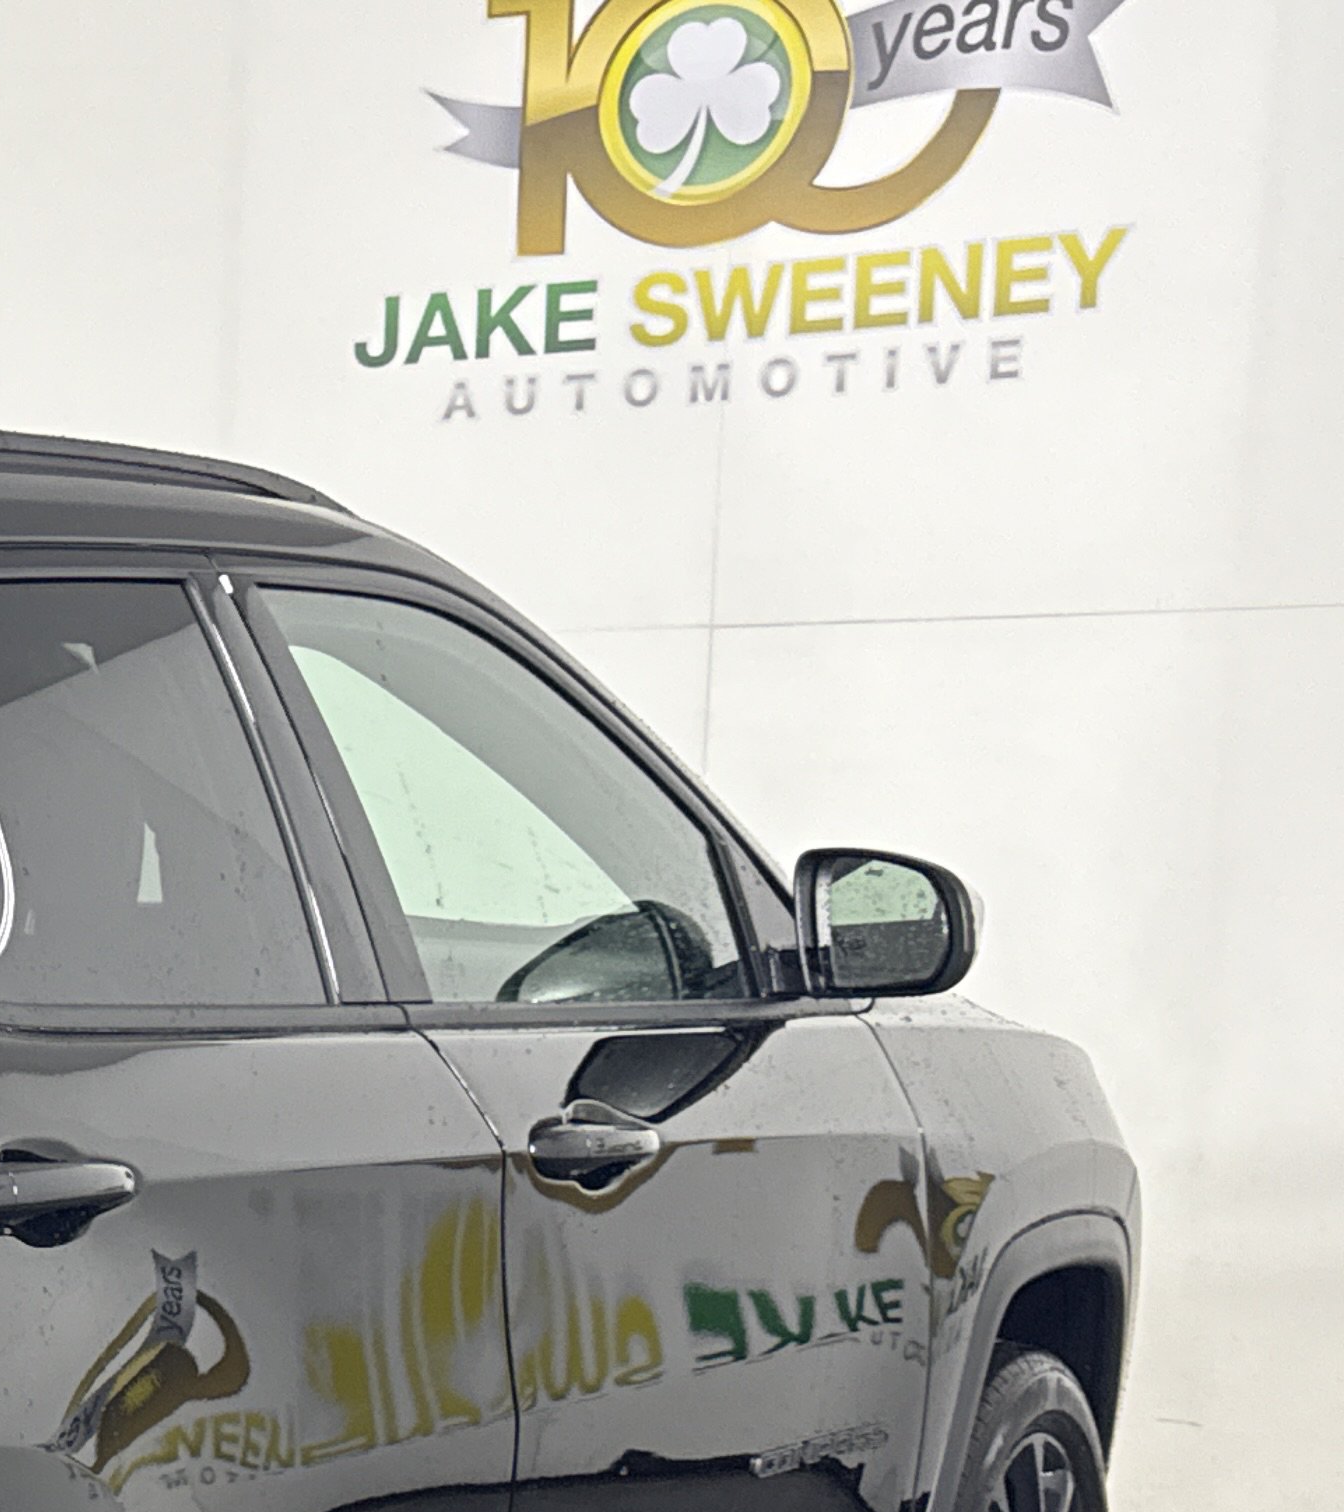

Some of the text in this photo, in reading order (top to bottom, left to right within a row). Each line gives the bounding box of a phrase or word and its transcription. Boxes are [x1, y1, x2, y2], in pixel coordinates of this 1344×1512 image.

[867, 0, 1073, 91] years
[353, 225, 1131, 368] JAKE SWEENEY
[441, 339, 1023, 422] AUTOMOTIVE
